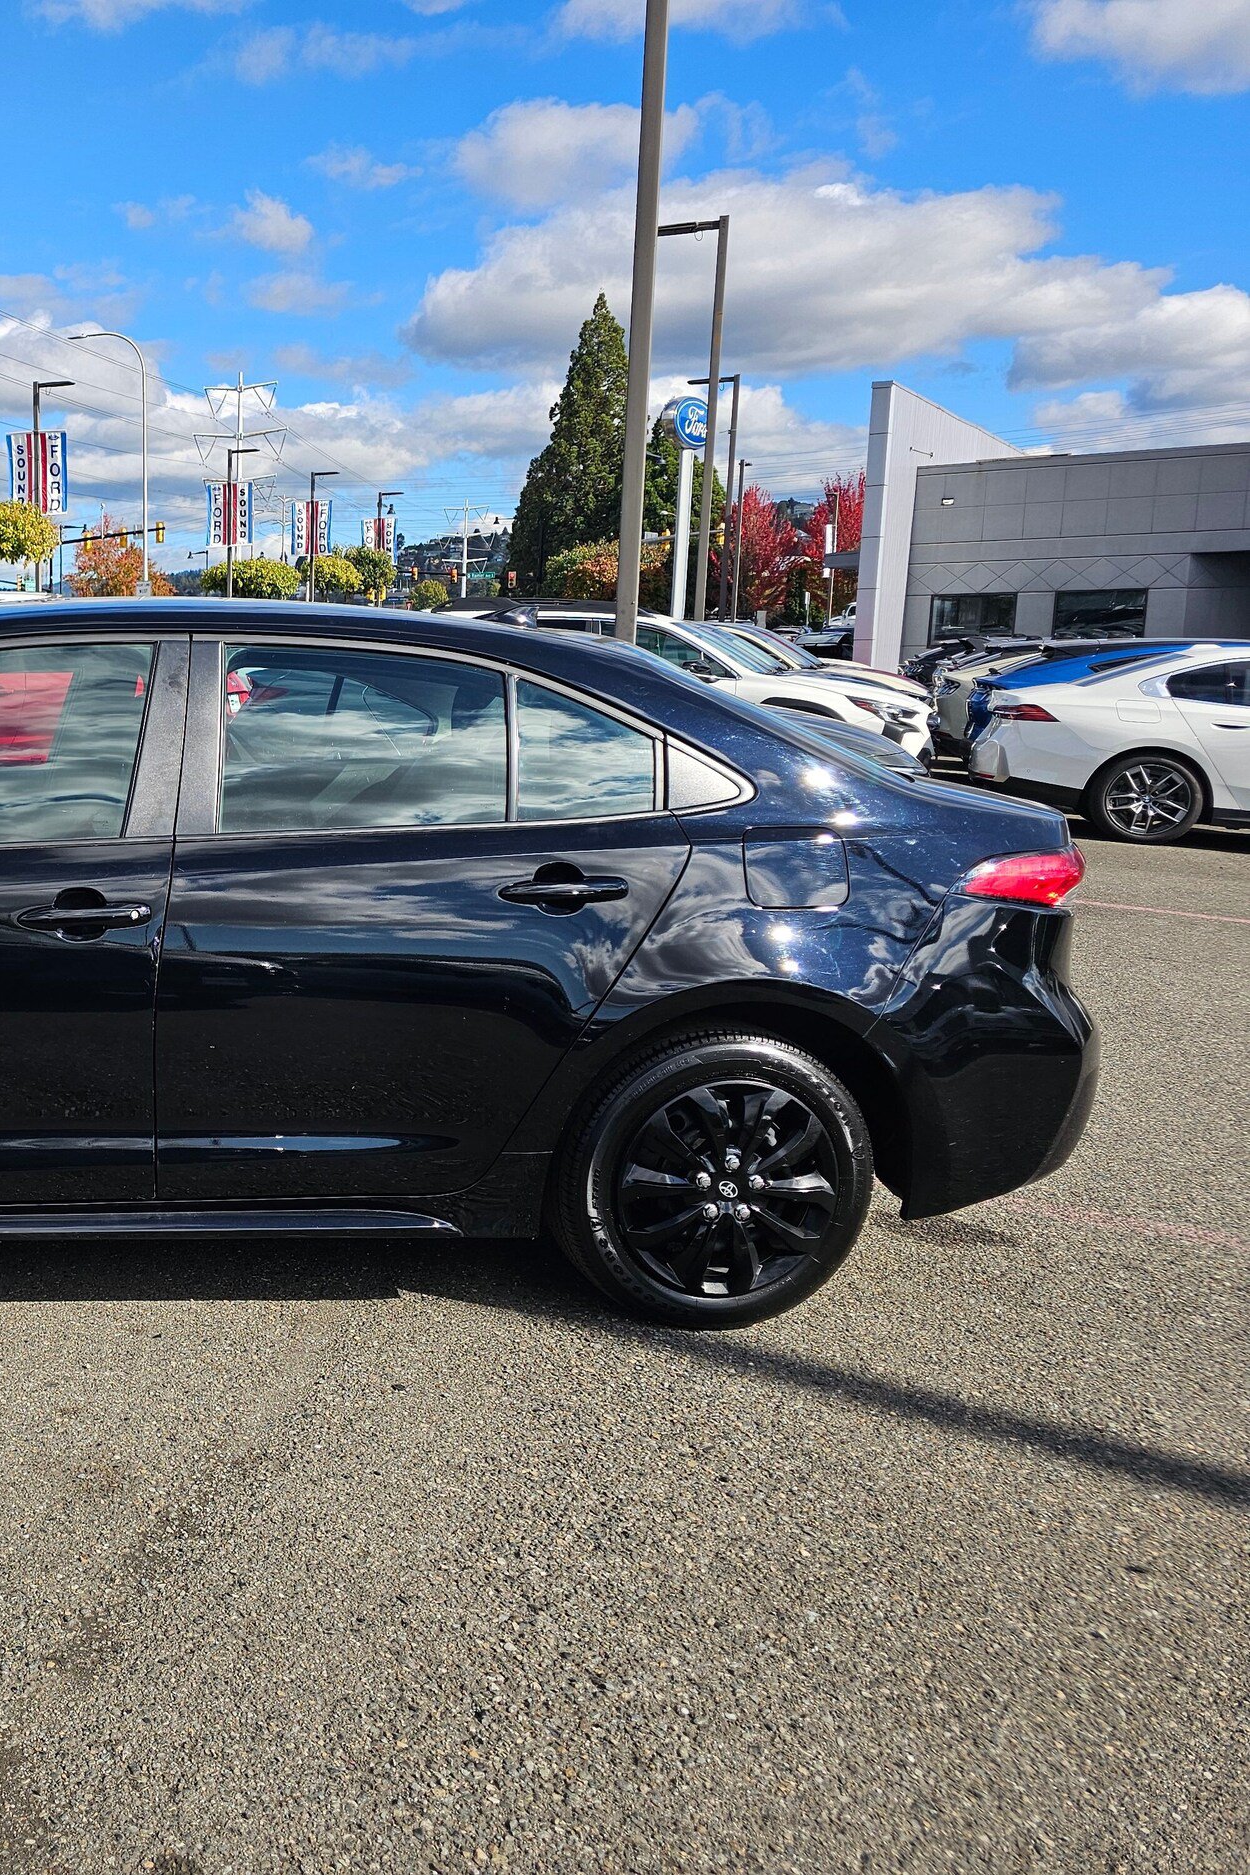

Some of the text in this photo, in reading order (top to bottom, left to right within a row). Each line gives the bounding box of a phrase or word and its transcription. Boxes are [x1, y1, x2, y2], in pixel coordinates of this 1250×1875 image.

[50, 444, 61, 511] FORD
[213, 494, 223, 544] FORD
[296, 508, 304, 548] SOUND
[318, 509, 327, 553] FORD
